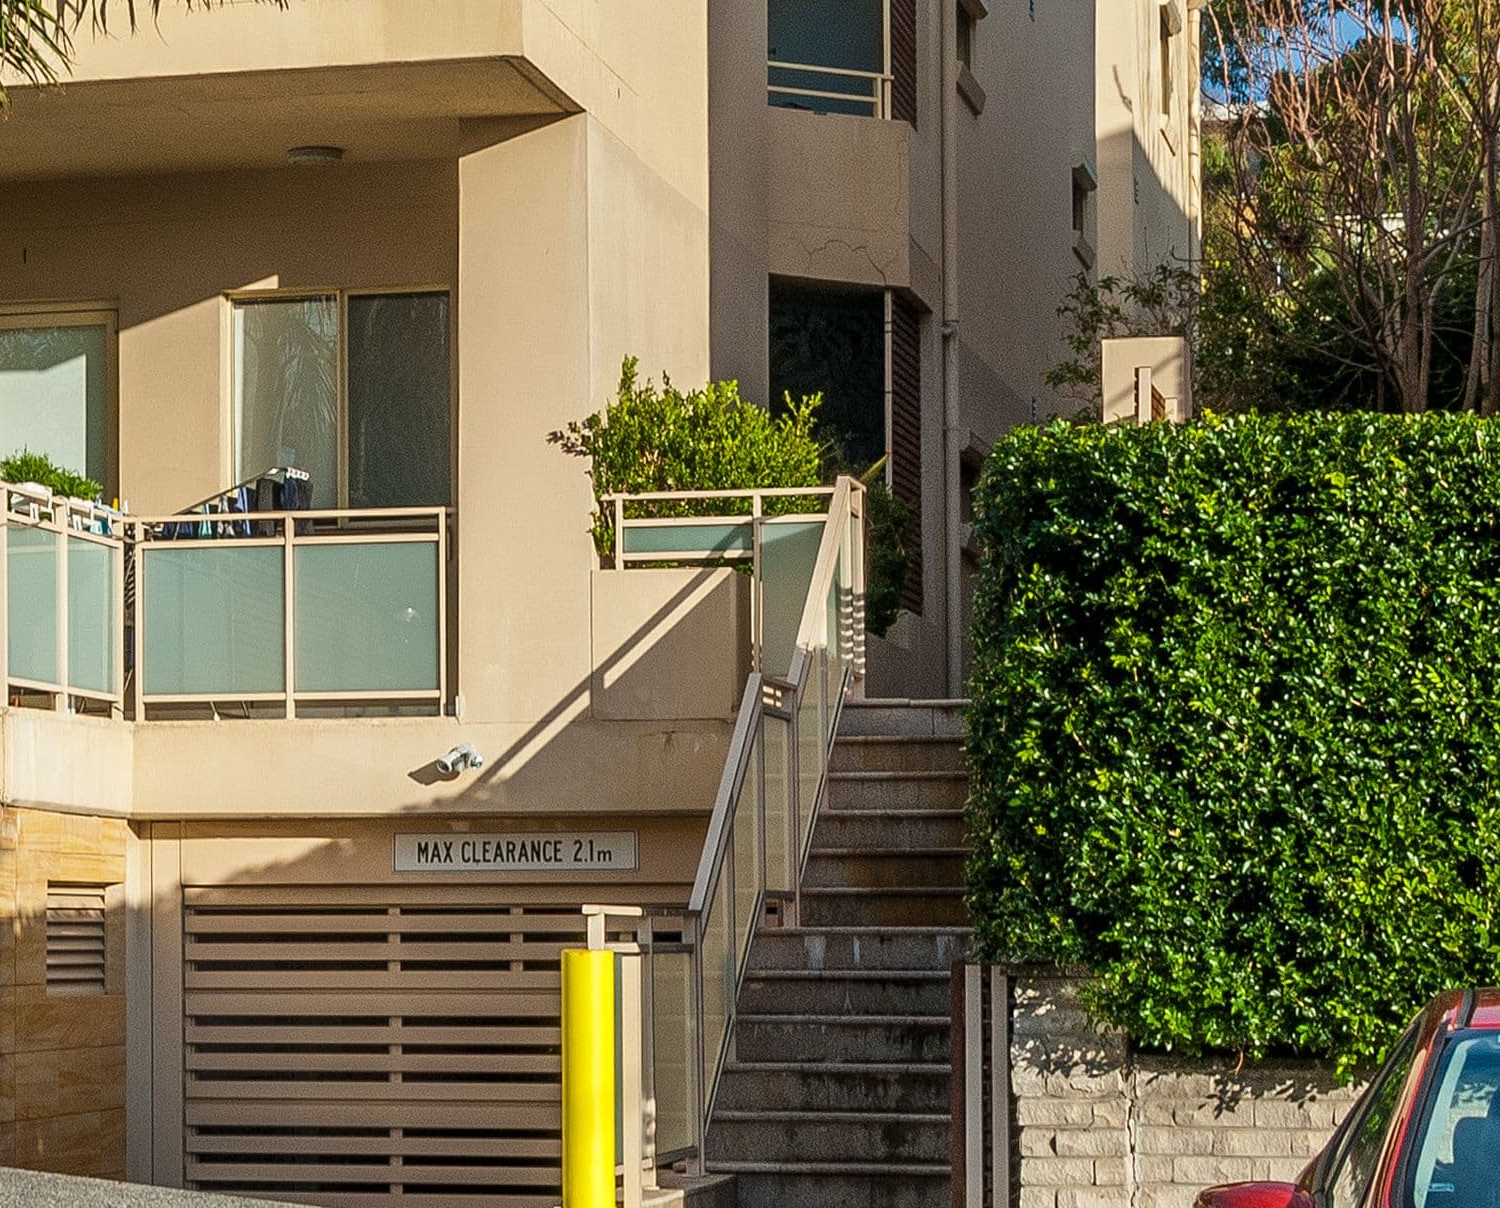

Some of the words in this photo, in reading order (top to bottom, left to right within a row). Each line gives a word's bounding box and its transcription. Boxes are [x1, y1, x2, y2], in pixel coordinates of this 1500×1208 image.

[417, 841, 453, 864] MAX
[461, 840, 563, 864] CLEARANCE
[572, 839, 613, 863] 2.1m
